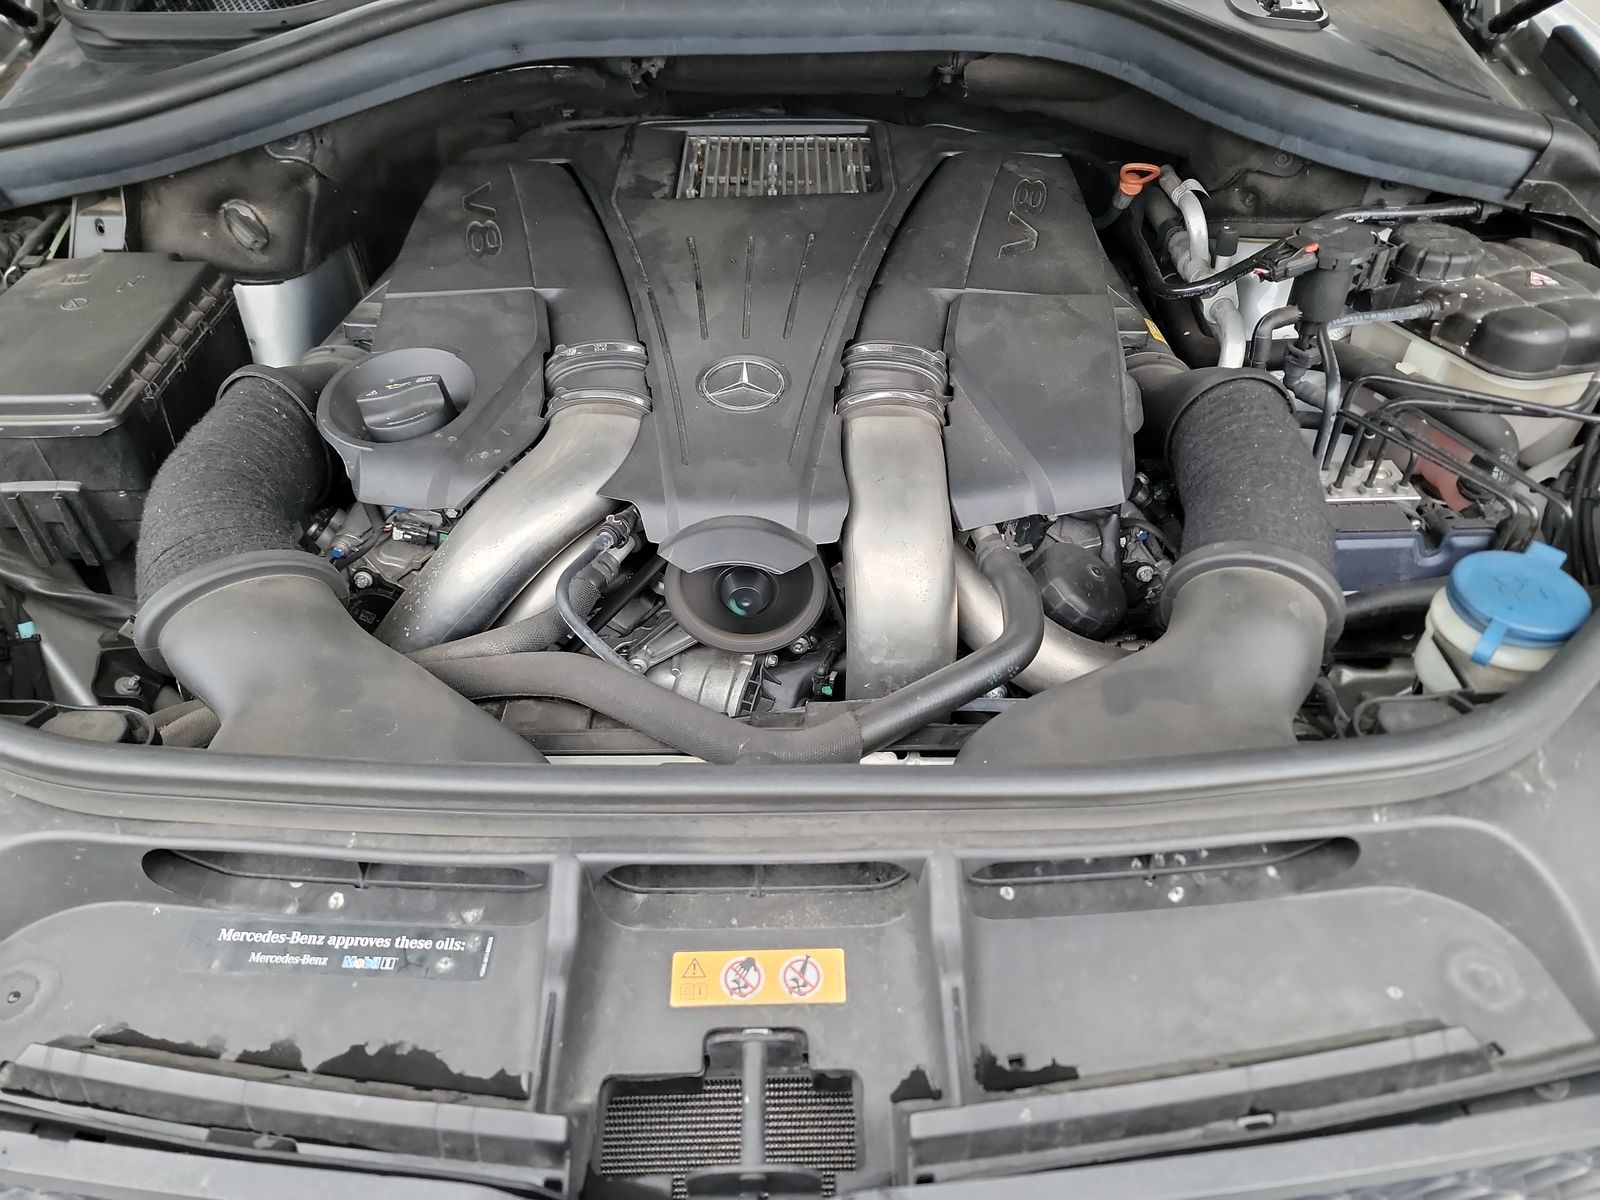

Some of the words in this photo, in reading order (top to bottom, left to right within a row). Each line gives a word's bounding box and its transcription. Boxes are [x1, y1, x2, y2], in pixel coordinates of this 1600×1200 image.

[462, 181, 503, 260] V8
[998, 179, 1048, 259] V8
[217, 928, 326, 945] Mercedes-Benz
[327, 935, 391, 949] approves
[394, 936, 432, 950] these
[435, 938, 466, 951] oils:
[248, 951, 329, 966] Mercedes-Benz
[342, 955, 381, 970] Mobil
